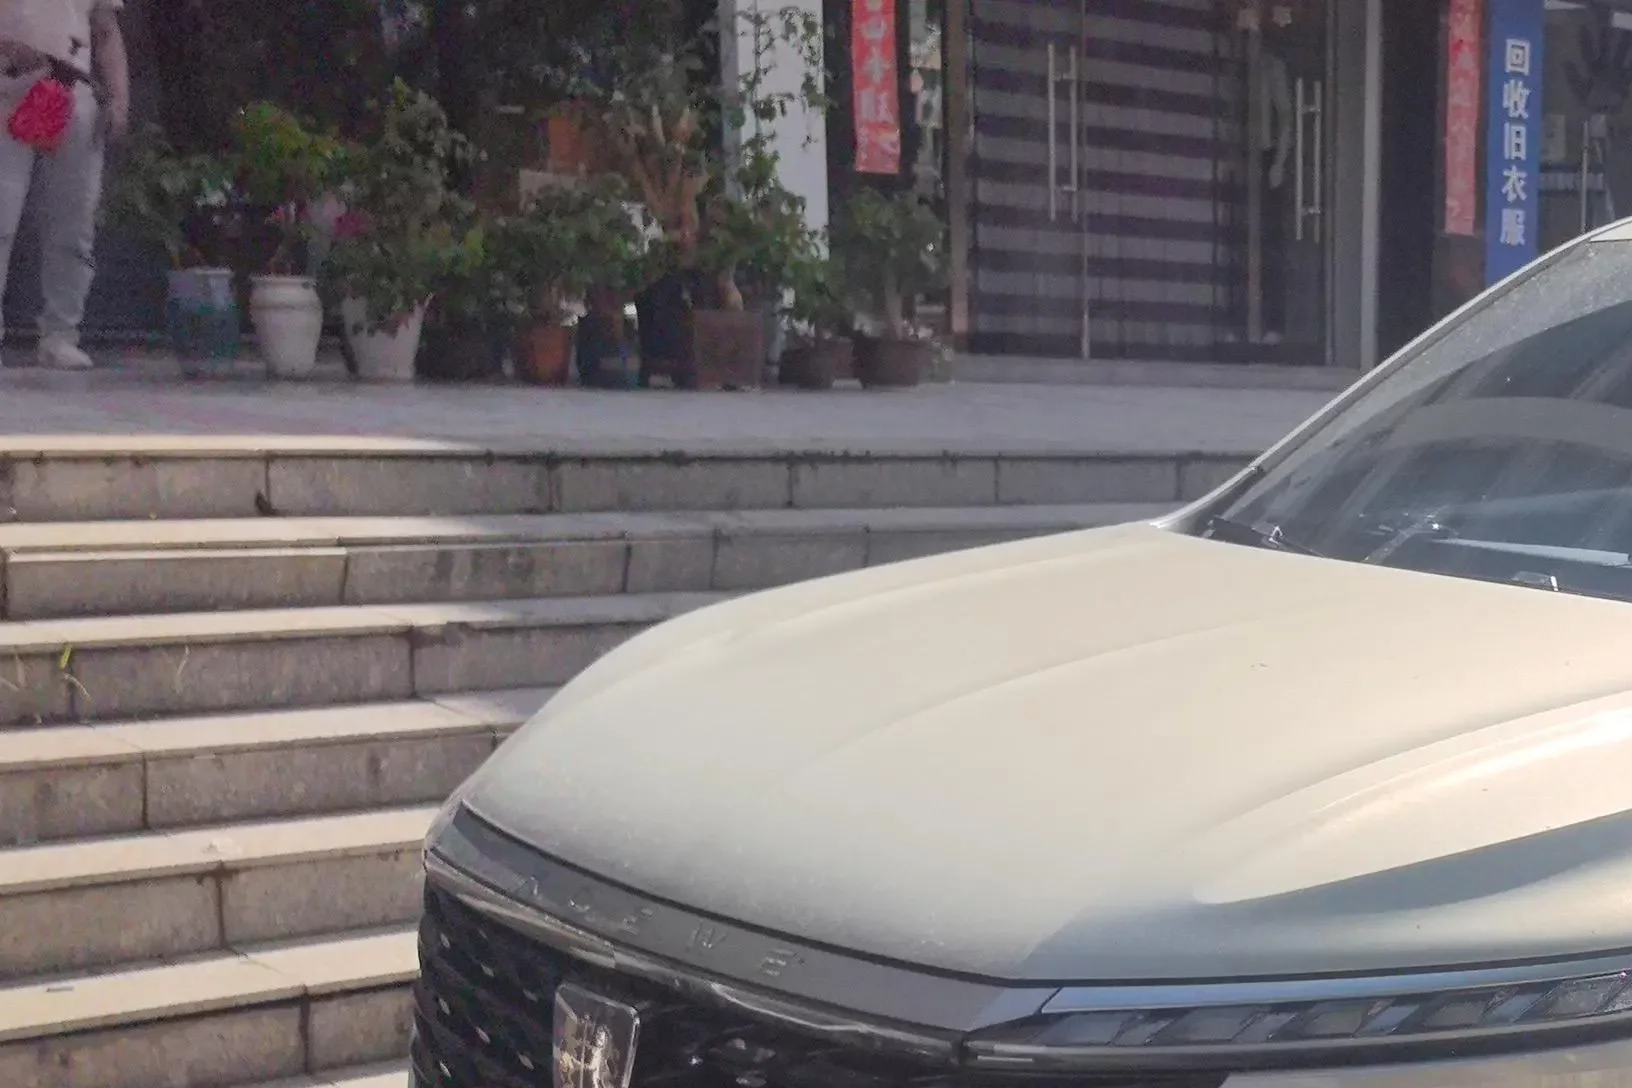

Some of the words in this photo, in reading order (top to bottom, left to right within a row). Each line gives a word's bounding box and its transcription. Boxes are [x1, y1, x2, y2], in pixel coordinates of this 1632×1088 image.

[1500, 38, 1532, 247] 回收旧衣服
